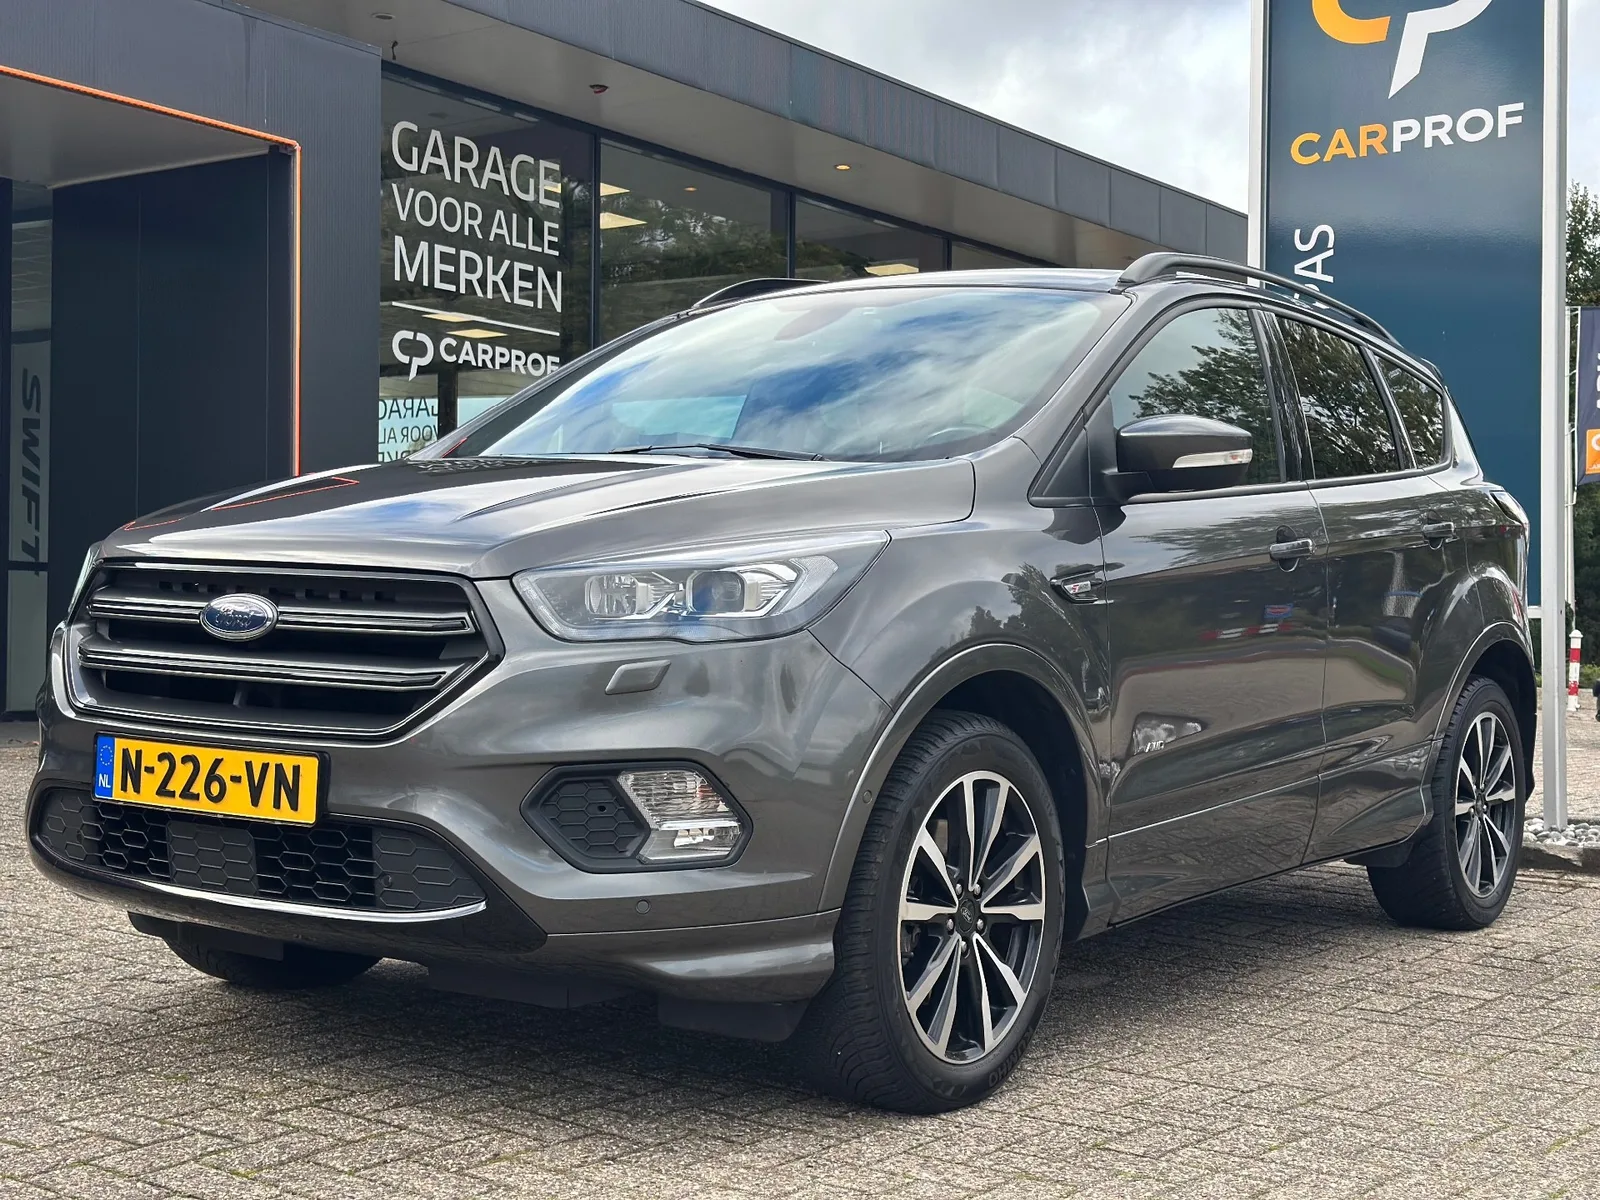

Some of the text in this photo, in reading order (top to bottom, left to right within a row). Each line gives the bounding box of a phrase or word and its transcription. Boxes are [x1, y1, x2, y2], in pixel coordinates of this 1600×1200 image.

[391, 120, 560, 208] GARAGE
[1290, 102, 1525, 165] CARPROF
[391, 184, 559, 256] VOOR ALLE
[393, 235, 562, 313] MERKEN
[440, 337, 560, 377] CARPROF
[21, 368, 41, 577] SWIFT
[98, 773, 111, 788] NL
[121, 748, 300, 811] N-226-VN
